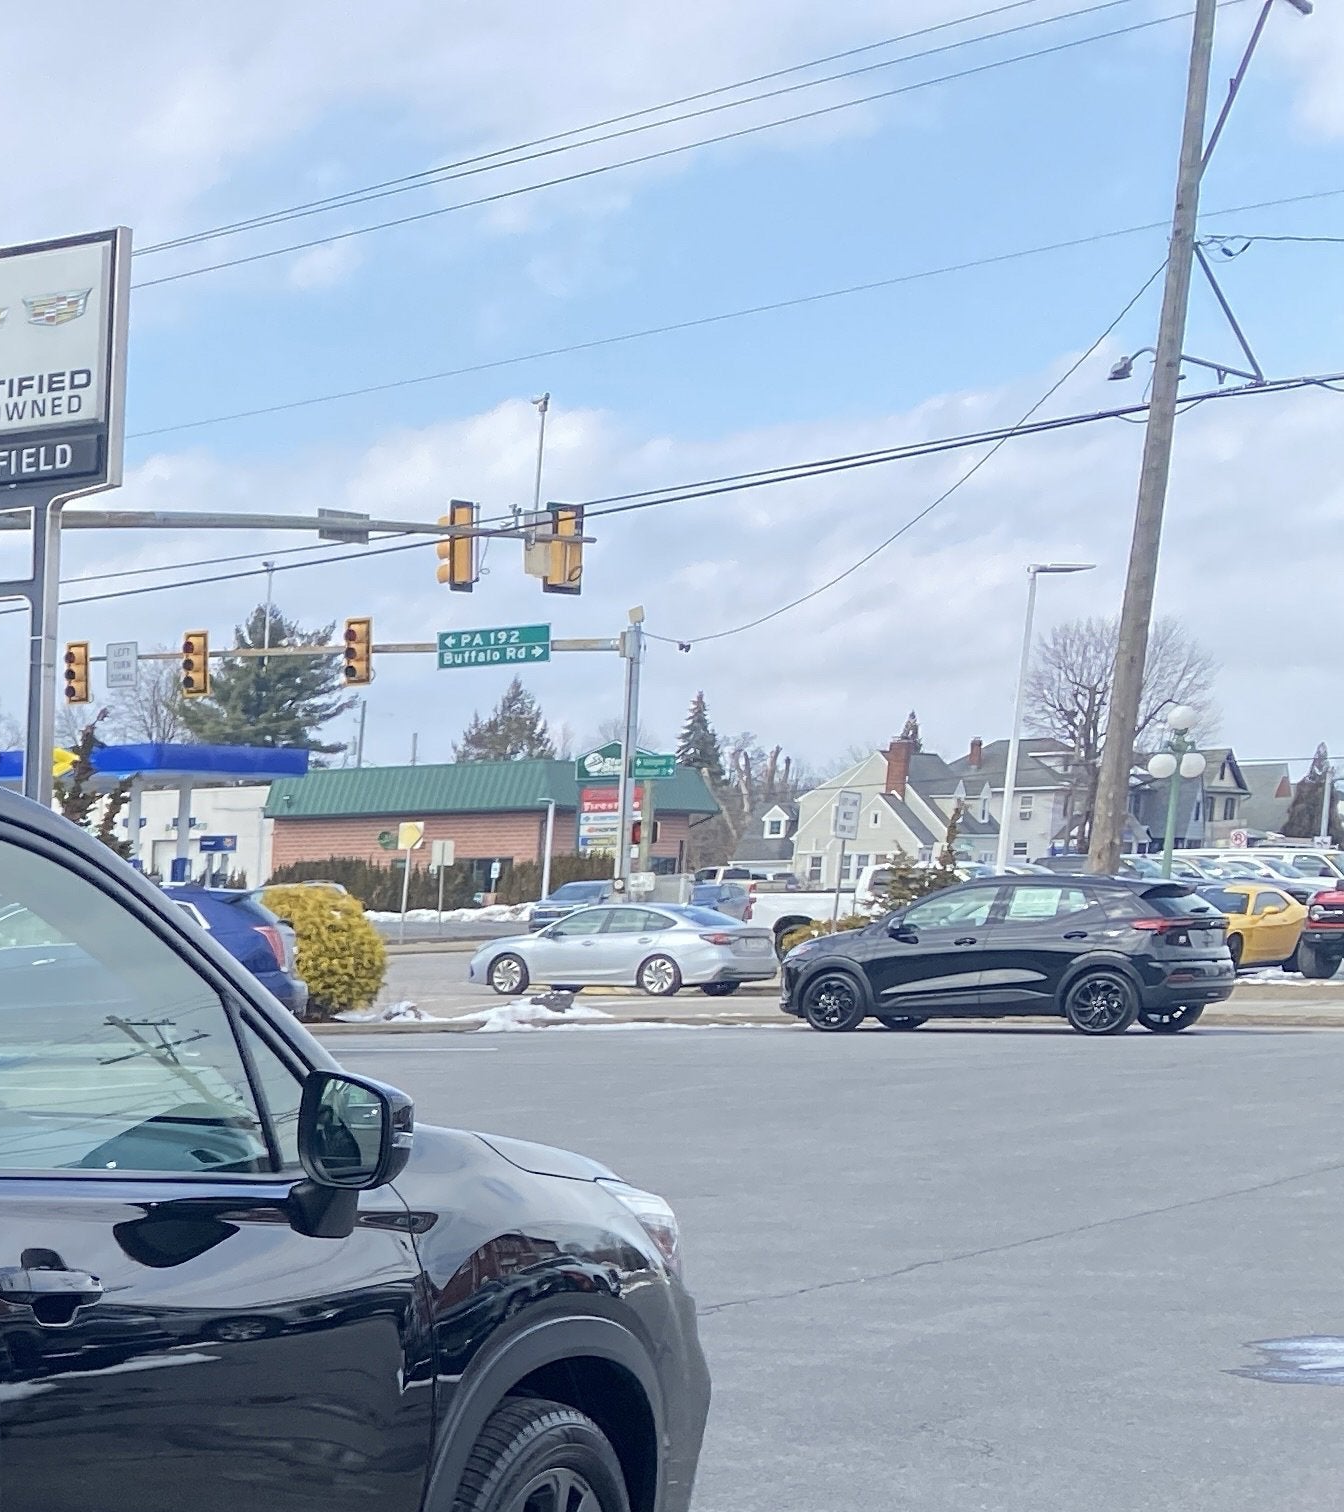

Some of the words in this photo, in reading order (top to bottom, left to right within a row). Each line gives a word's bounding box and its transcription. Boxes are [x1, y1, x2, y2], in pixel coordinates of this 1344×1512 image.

[460, 633, 484, 647] PA
[489, 630, 520, 645] 192
[443, 649, 501, 665] Buffalo
[505, 646, 526, 660] Rd
